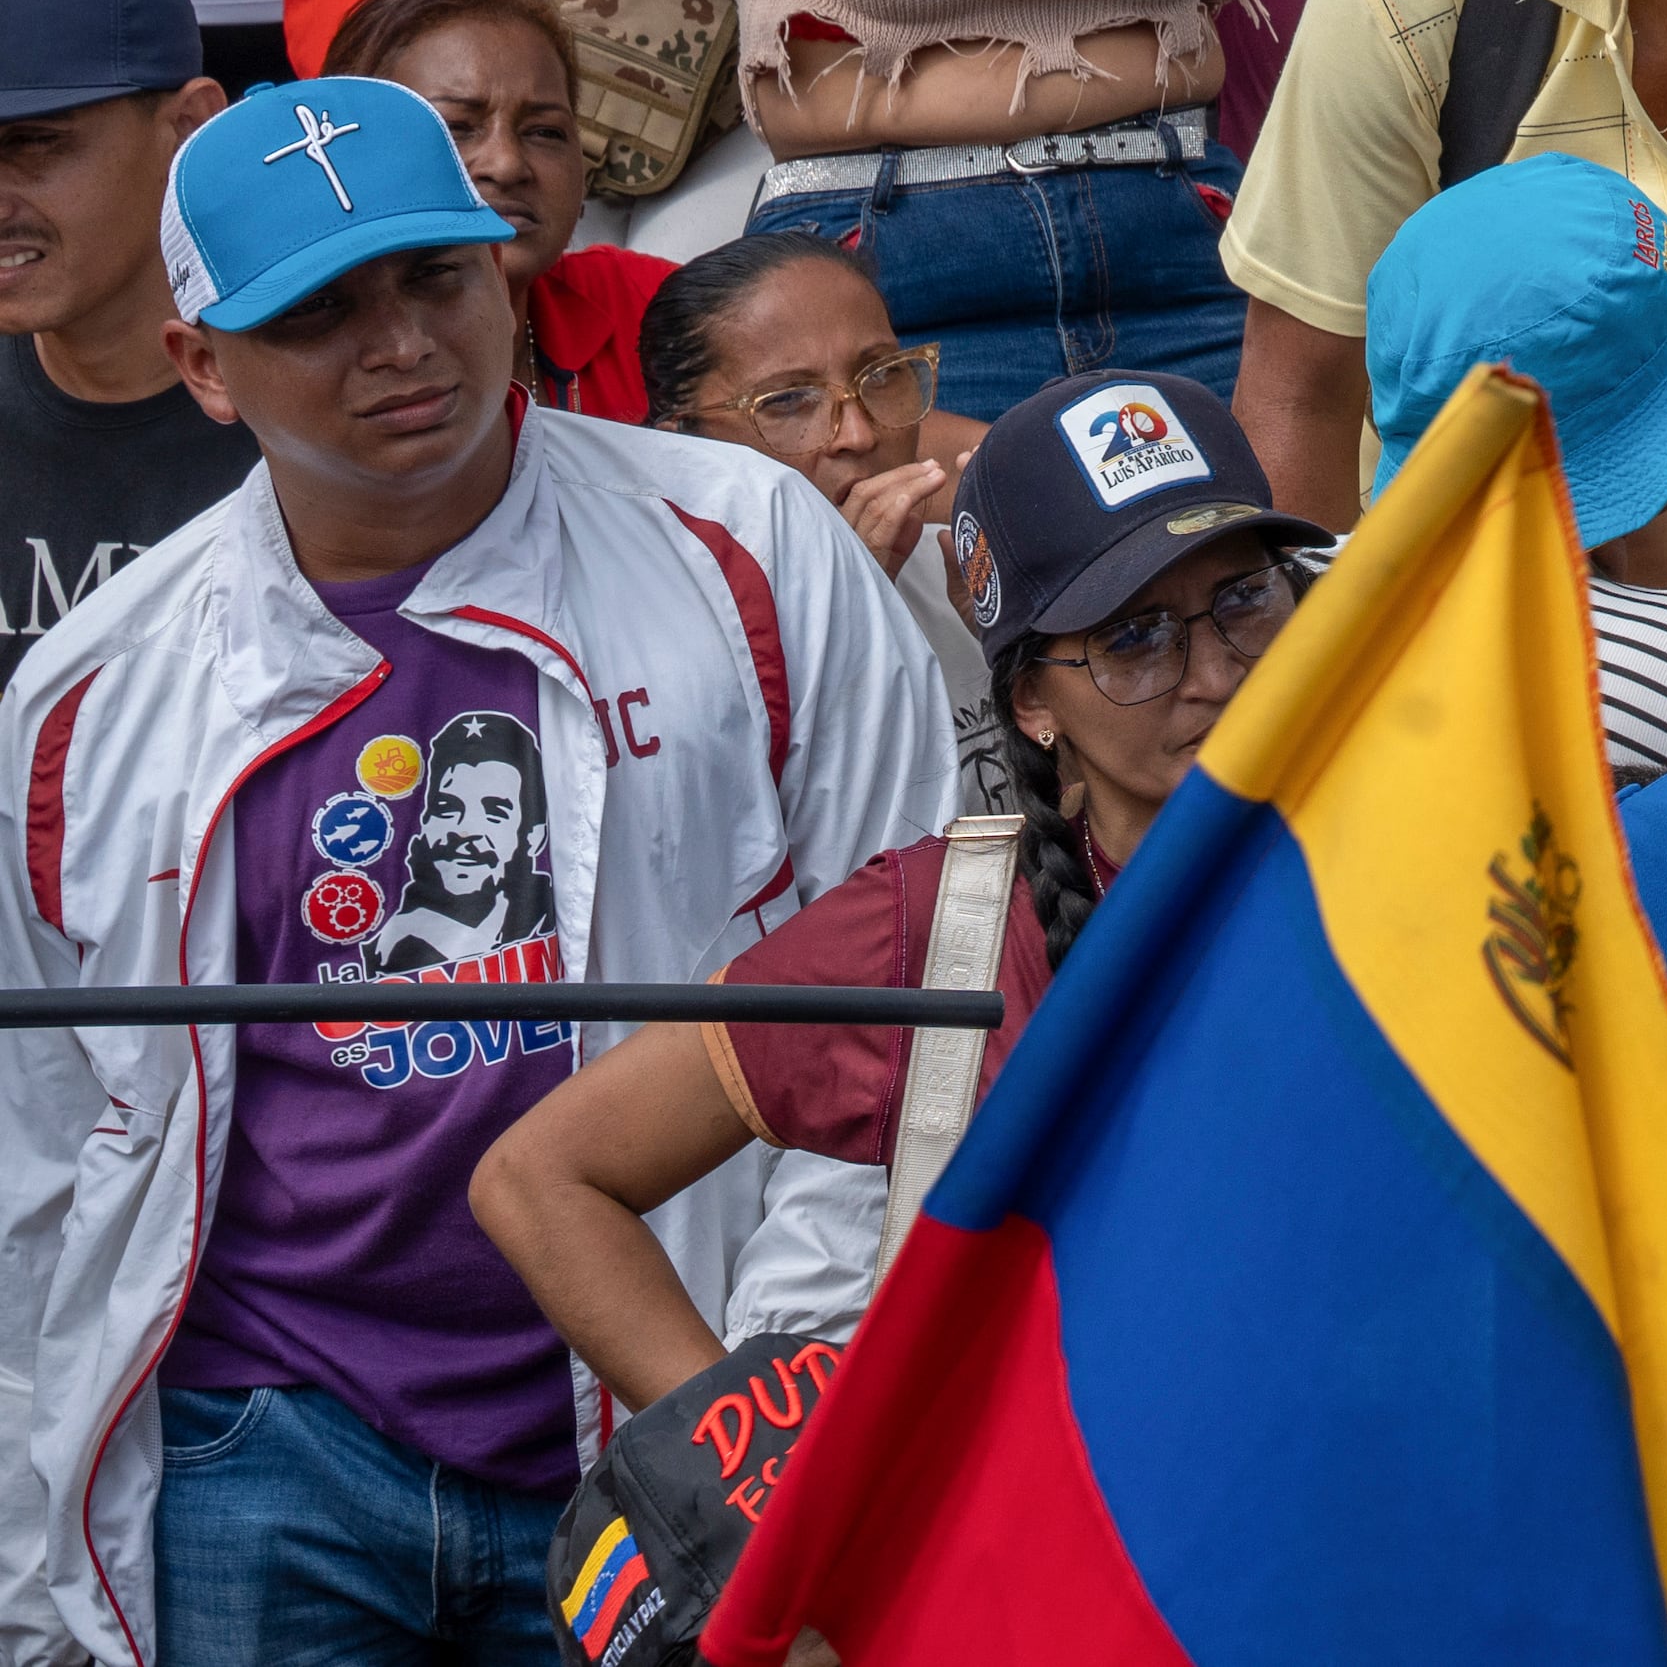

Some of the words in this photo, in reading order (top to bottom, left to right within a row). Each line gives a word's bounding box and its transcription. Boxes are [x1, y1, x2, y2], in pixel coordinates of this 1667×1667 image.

[1628, 199, 1660, 270] LARIOS
[1089, 401, 1169, 463] 20
[1100, 463, 1135, 489] LUIS
[1135, 447, 1195, 476] APARICIO
[317, 960, 365, 985] La
[331, 1043, 368, 1067] es
[361, 1020, 573, 1090] JOVE
